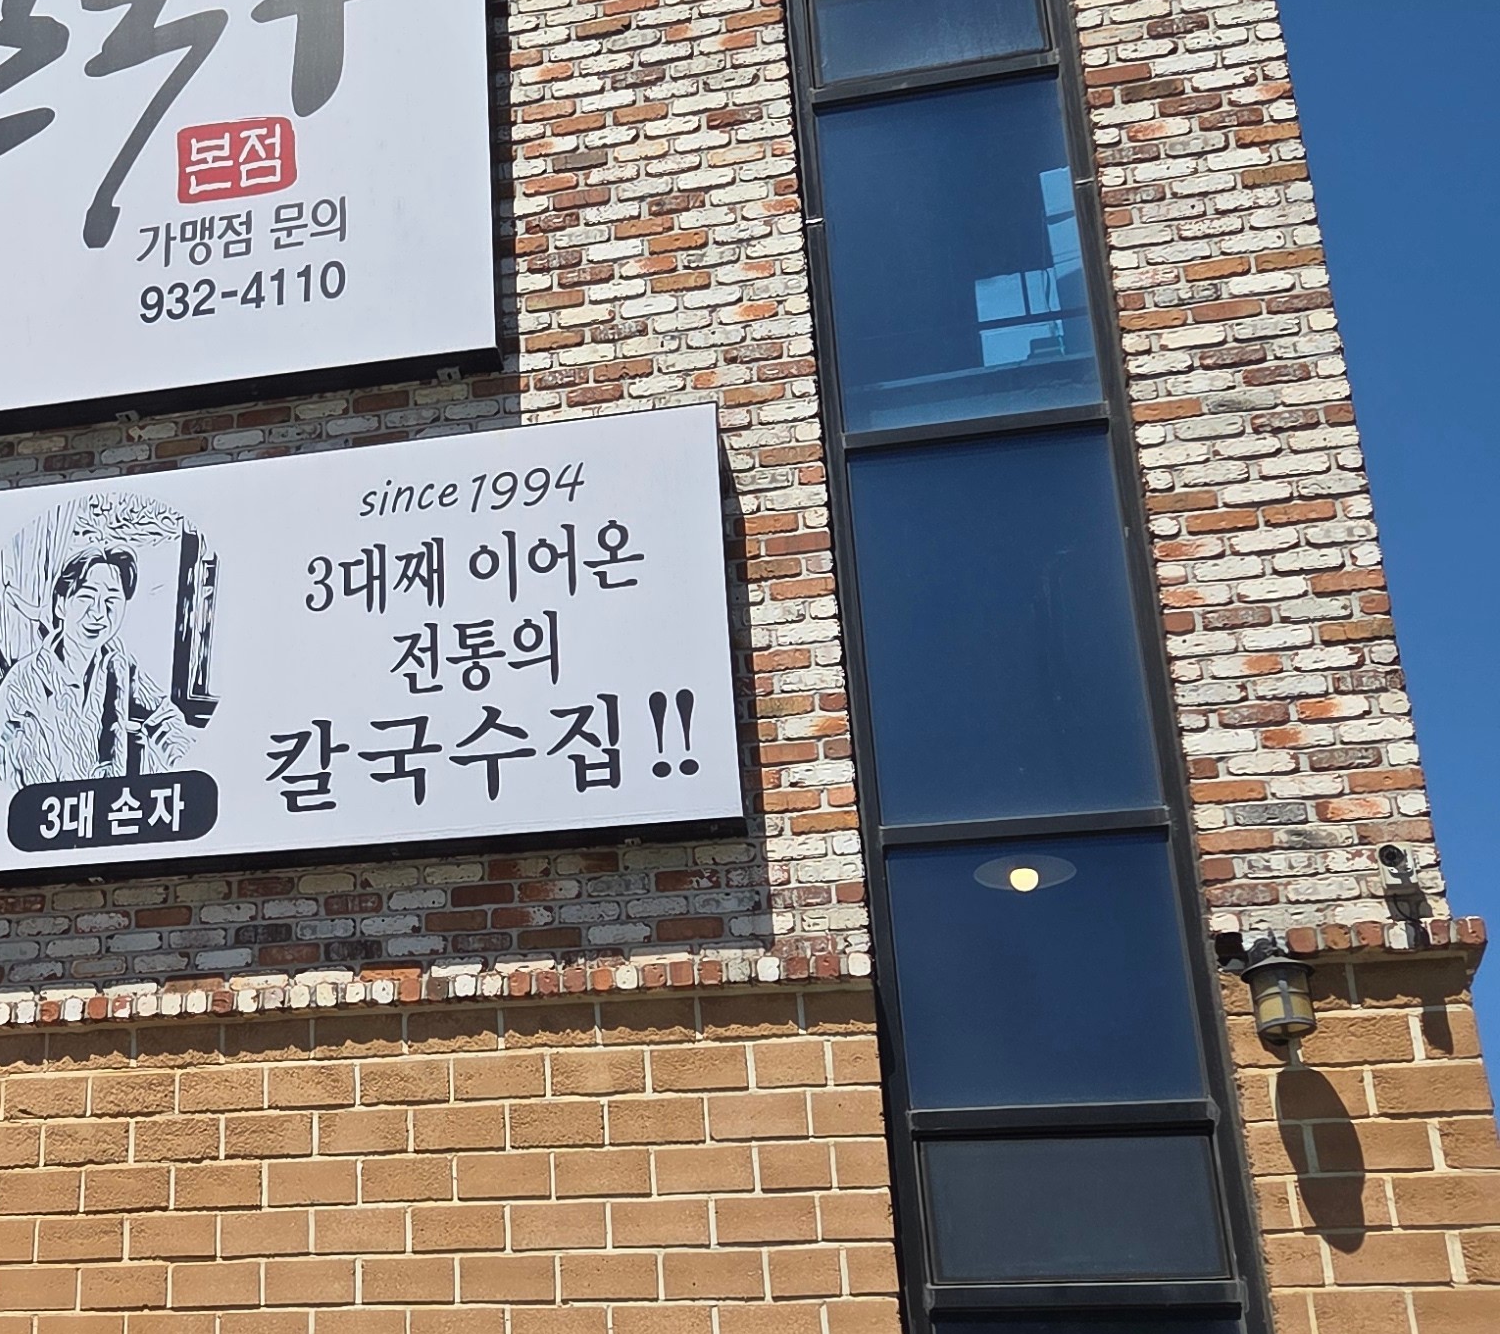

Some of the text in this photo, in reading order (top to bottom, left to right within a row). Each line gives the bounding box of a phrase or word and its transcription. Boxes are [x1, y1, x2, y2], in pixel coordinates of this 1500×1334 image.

[185, 123, 282, 195] 본점
[136, 195, 346, 268] 가맹점 문의
[139, 260, 346, 324] 932-4110
[359, 461, 586, 517] since 1994
[304, 518, 646, 615] 3대째 이어온
[389, 609, 561, 695] 전통의
[39, 782, 186, 840] 3대 손자
